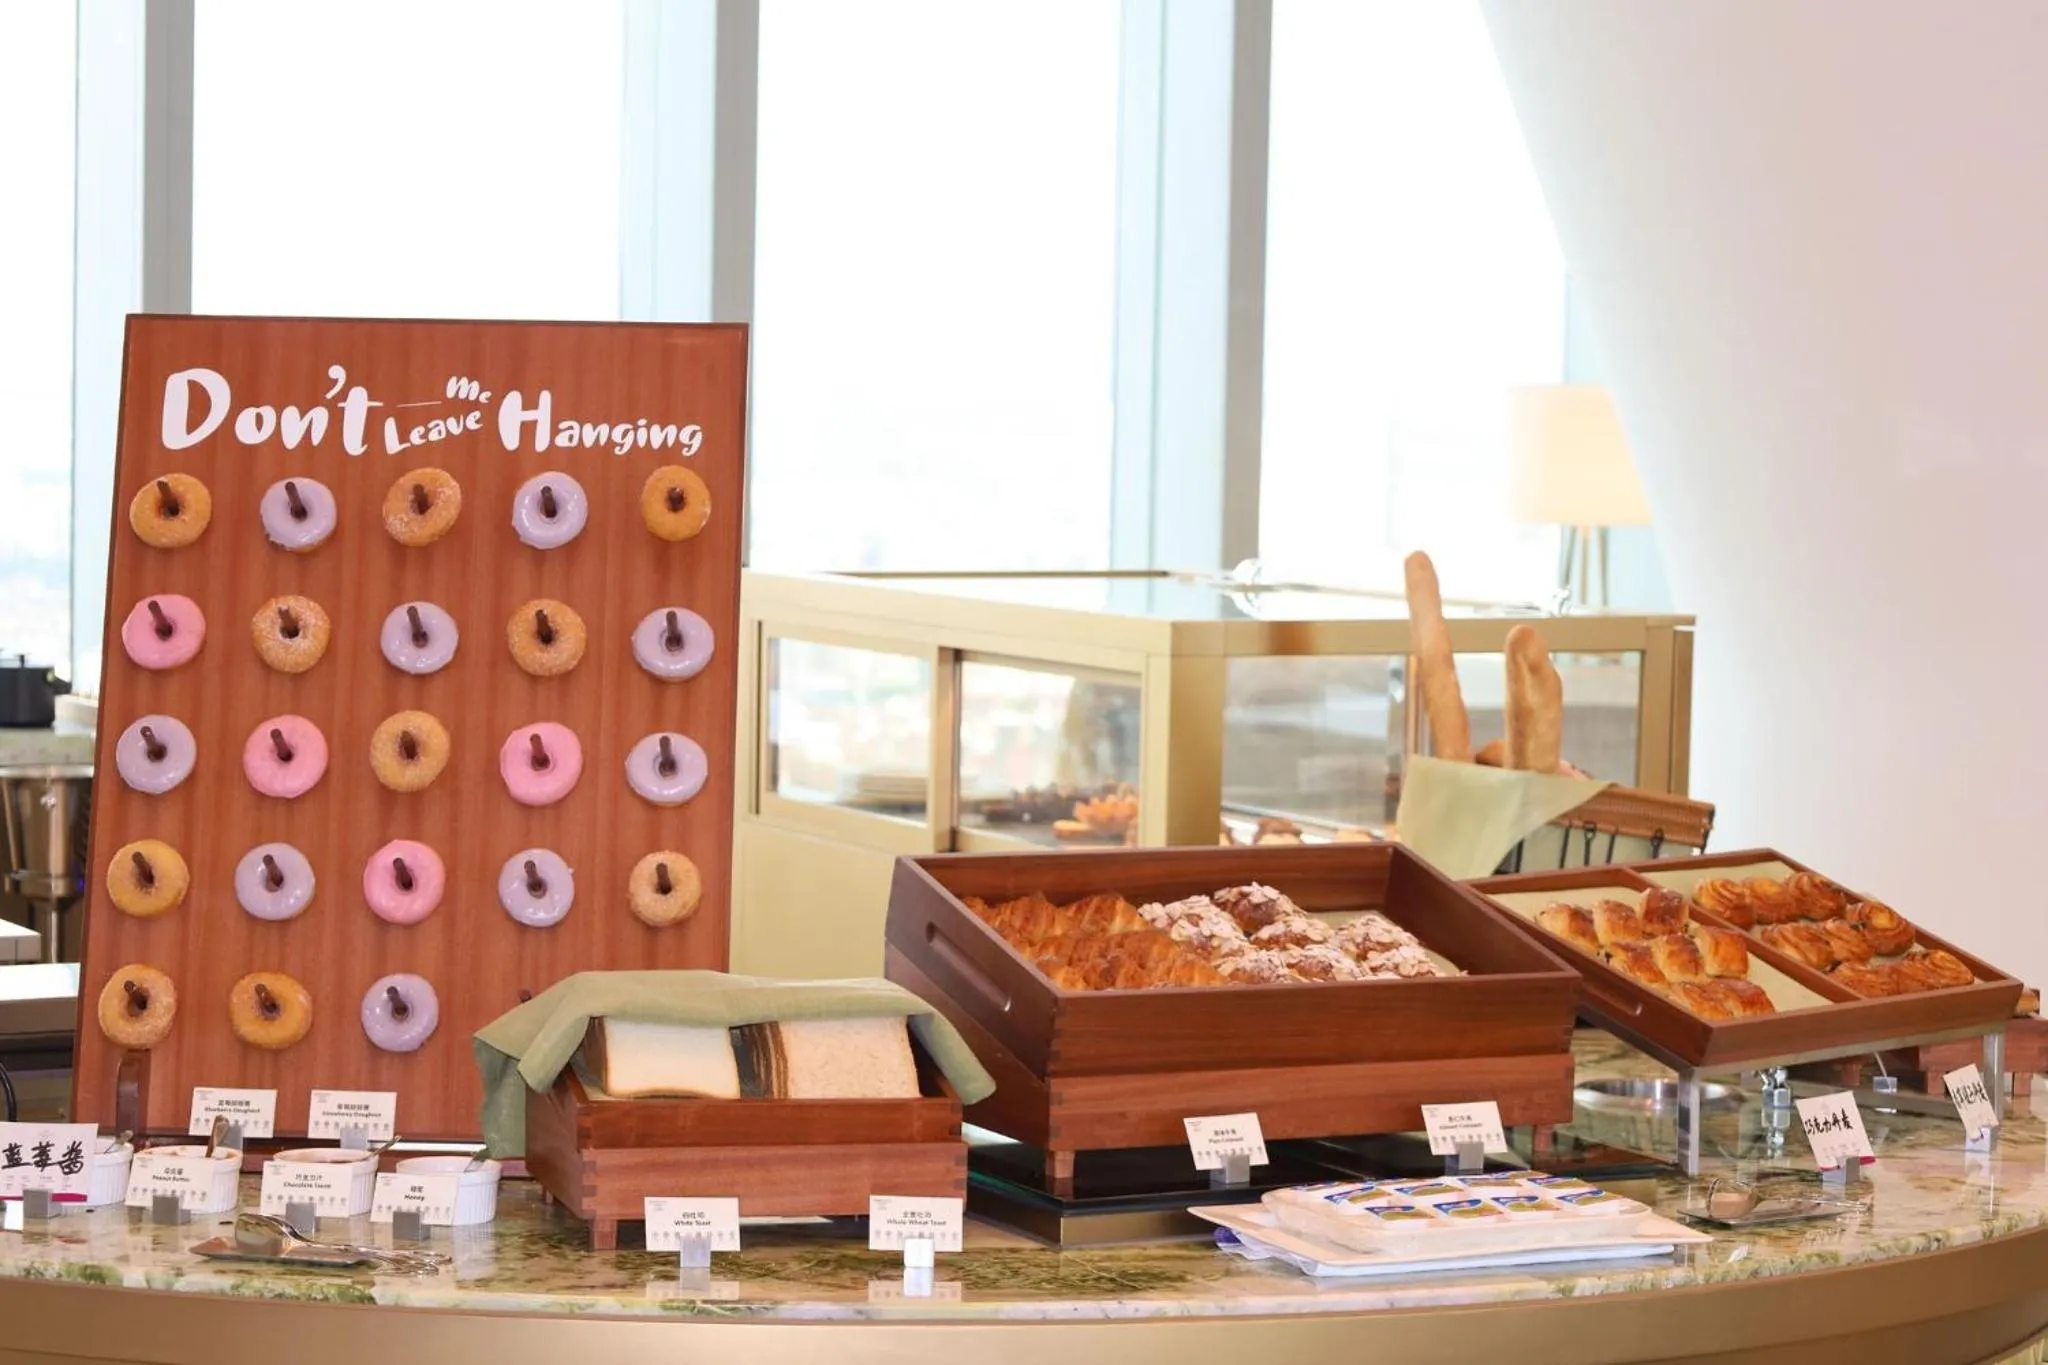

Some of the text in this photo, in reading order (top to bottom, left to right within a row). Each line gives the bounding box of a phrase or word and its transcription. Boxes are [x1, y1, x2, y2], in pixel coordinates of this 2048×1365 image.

[161, 364, 384, 457] Don't
[384, 410, 483, 455] Leave
[498, 389, 703, 457] Hanging
[404, 1194, 425, 1202] Honey
